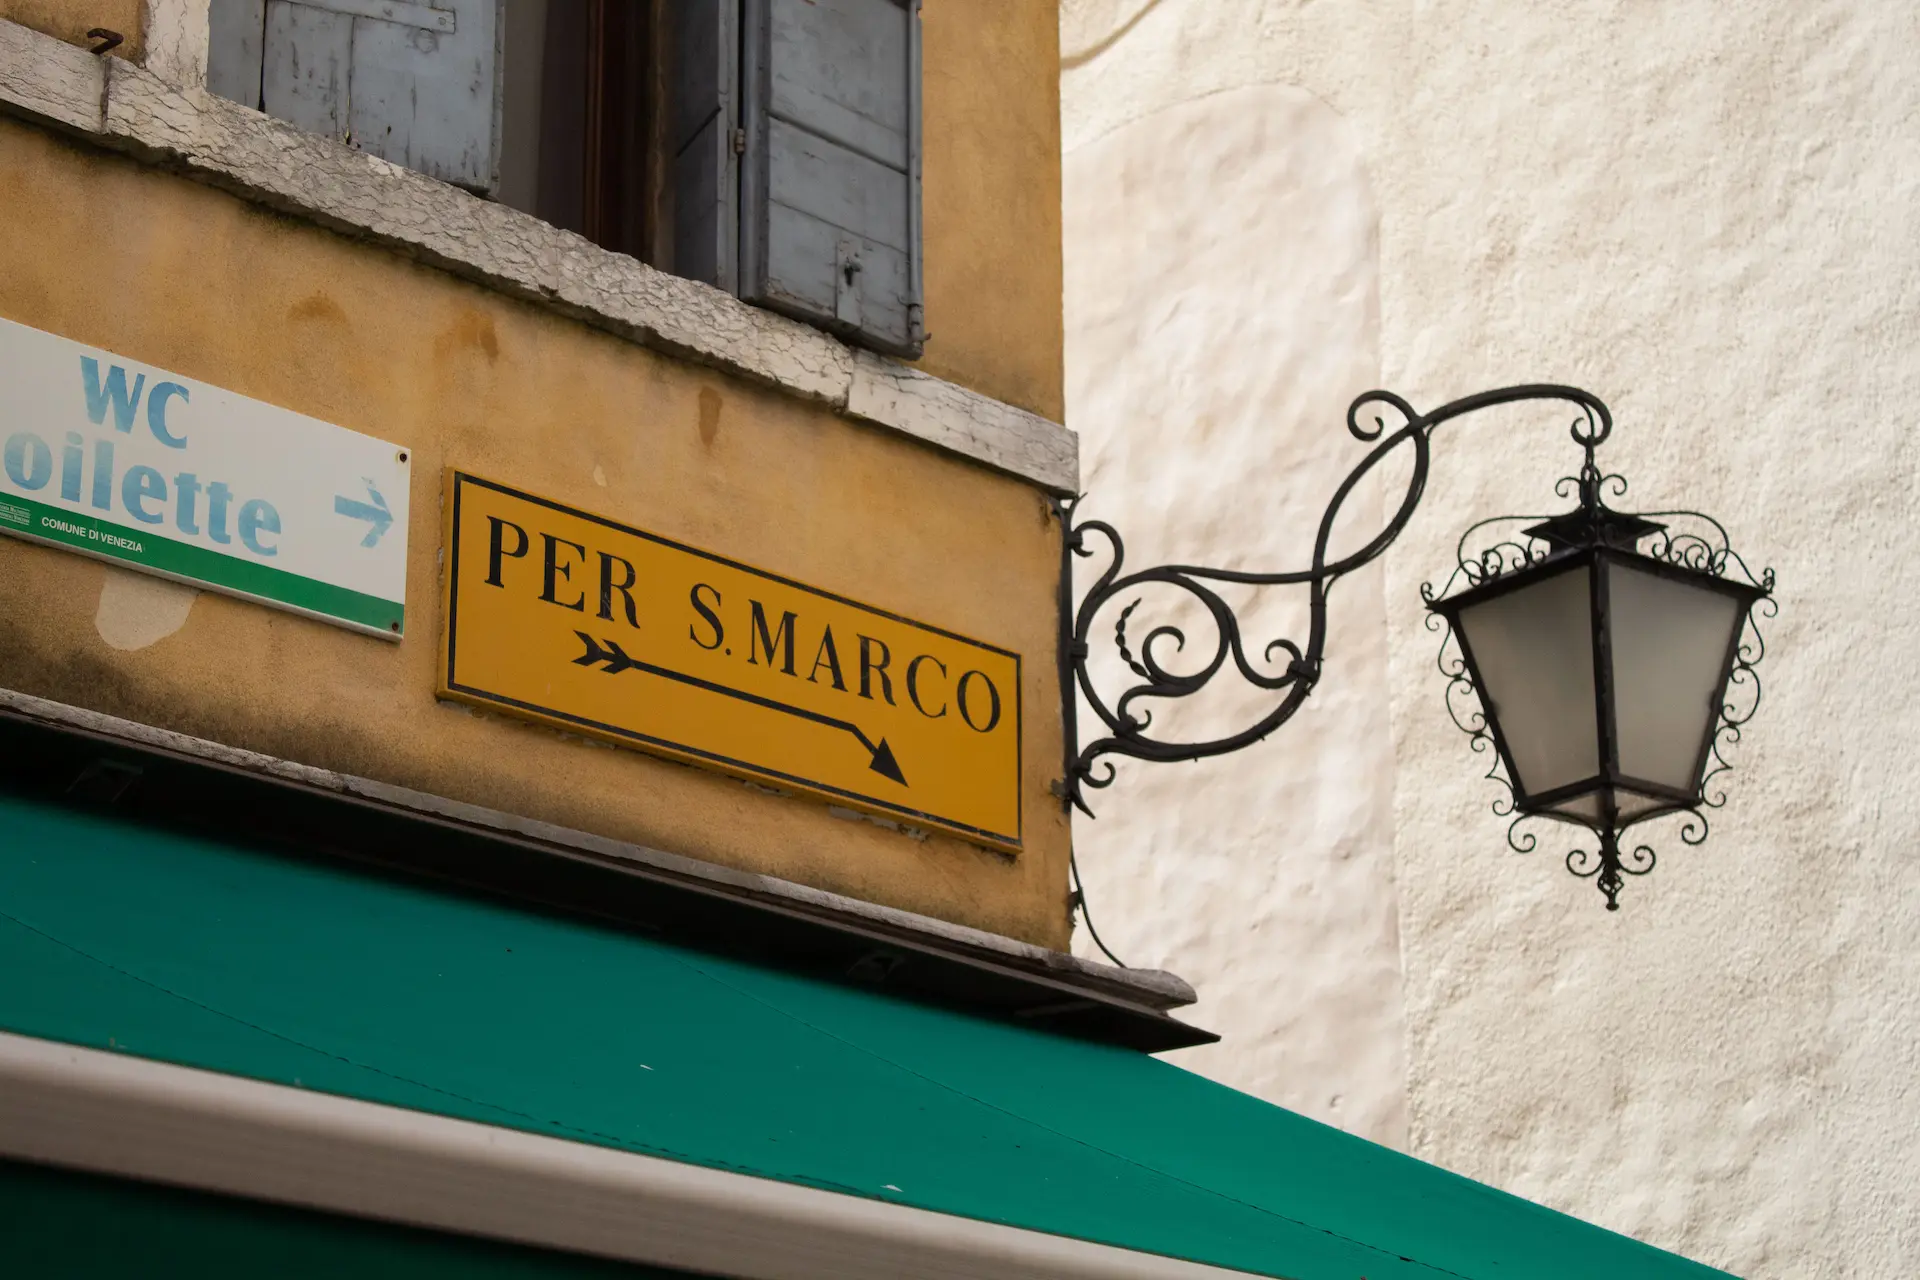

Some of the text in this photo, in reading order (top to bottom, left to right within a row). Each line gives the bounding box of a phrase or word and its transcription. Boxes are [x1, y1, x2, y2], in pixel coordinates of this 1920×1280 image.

[80, 355, 190, 449] WC
[41, 516, 86, 537] COMUNE
[88, 529, 99, 541] DI
[100, 533, 143, 553] VENEZIA
[484, 515, 641, 629] PER
